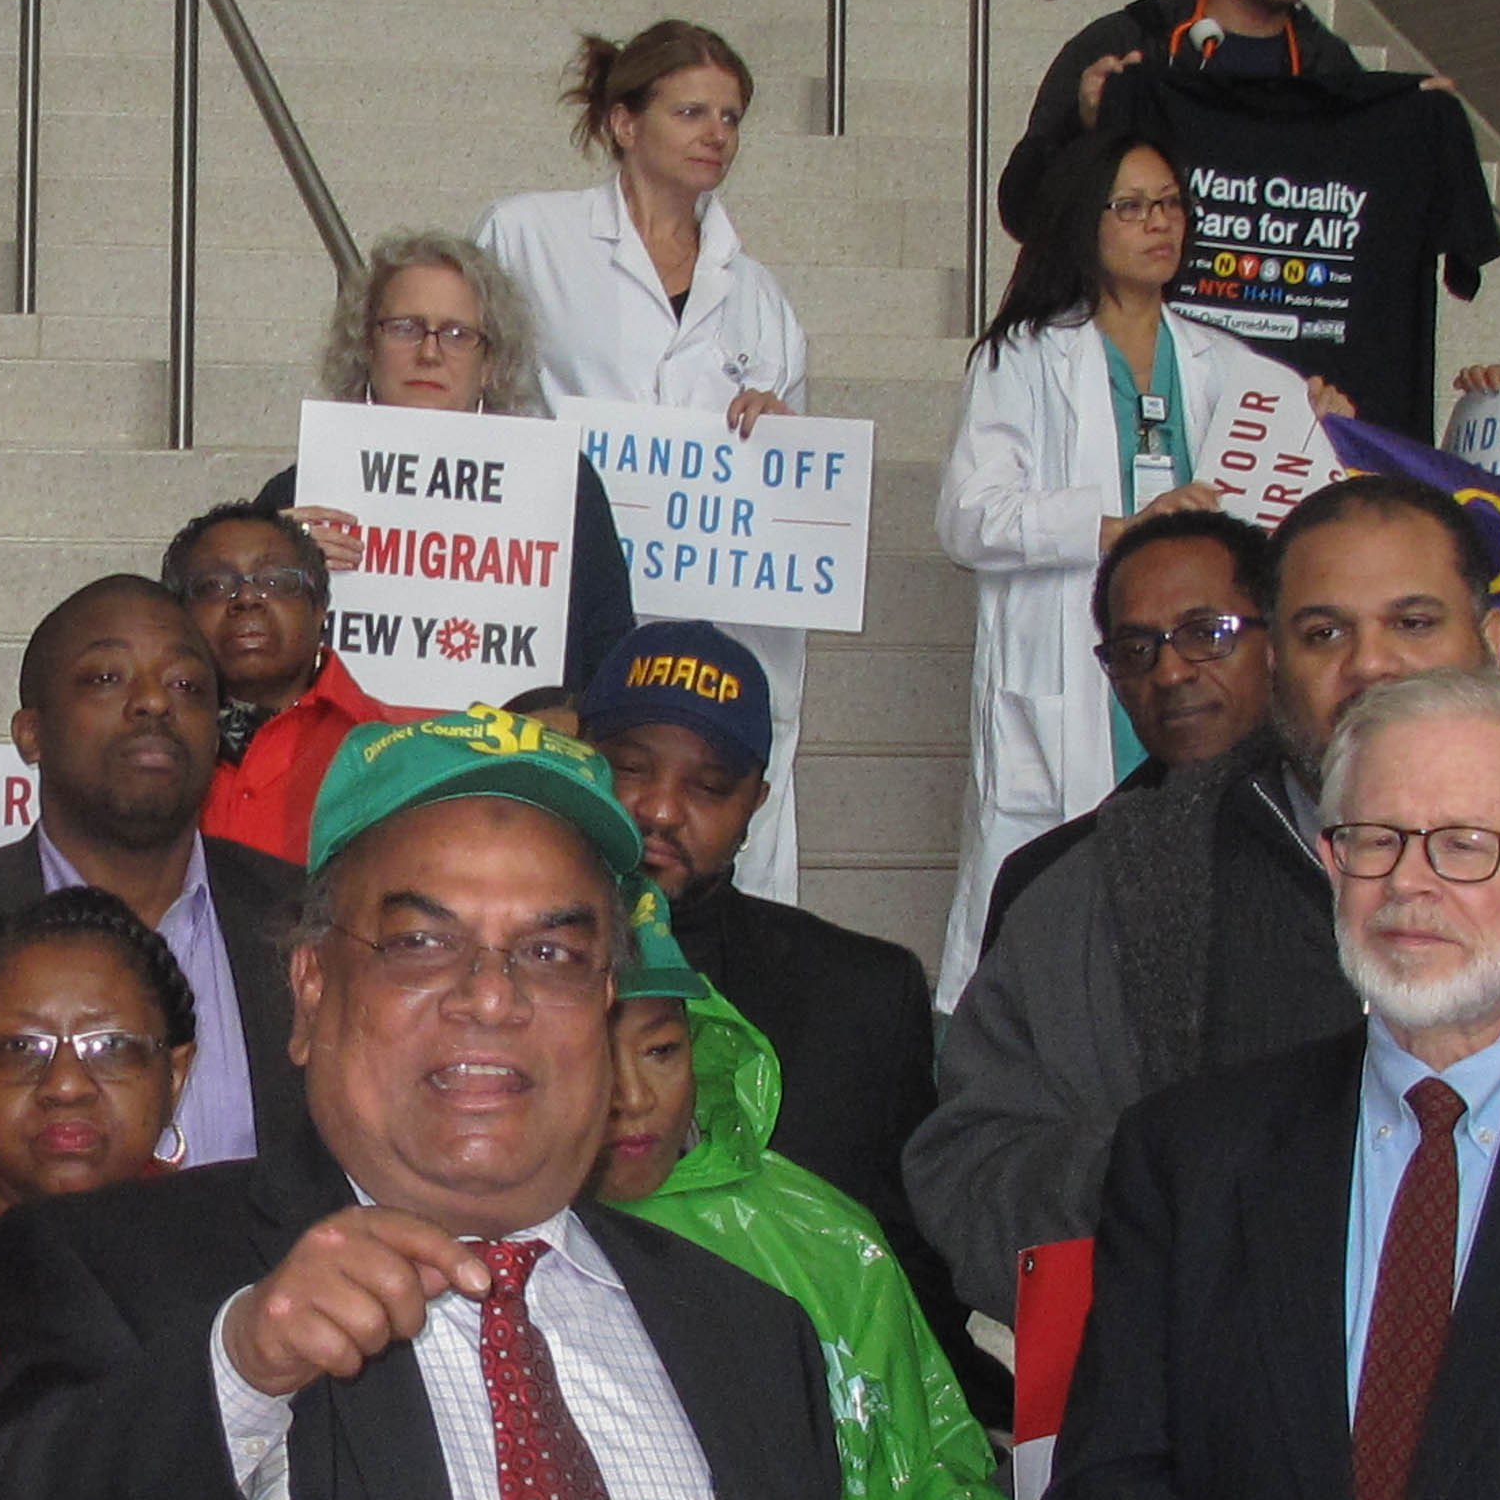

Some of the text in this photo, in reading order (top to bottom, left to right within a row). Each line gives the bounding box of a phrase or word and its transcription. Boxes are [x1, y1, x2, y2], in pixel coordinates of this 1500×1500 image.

[1265, 178, 1367, 219] Quality
[1259, 213, 1298, 245] for
[1304, 218, 1360, 249] All?
[1198, 279, 1240, 299] NYC
[360, 450, 505, 503] WE ARE
[587, 430, 845, 490] HANDS OFF
[667, 491, 754, 537] OUR
[314, 520, 559, 587] MIGRANT
[619, 537, 835, 595] SPITALS
[626, 655, 742, 704] NAACP
[364, 726, 414, 763] District
[420, 721, 484, 740] Council
